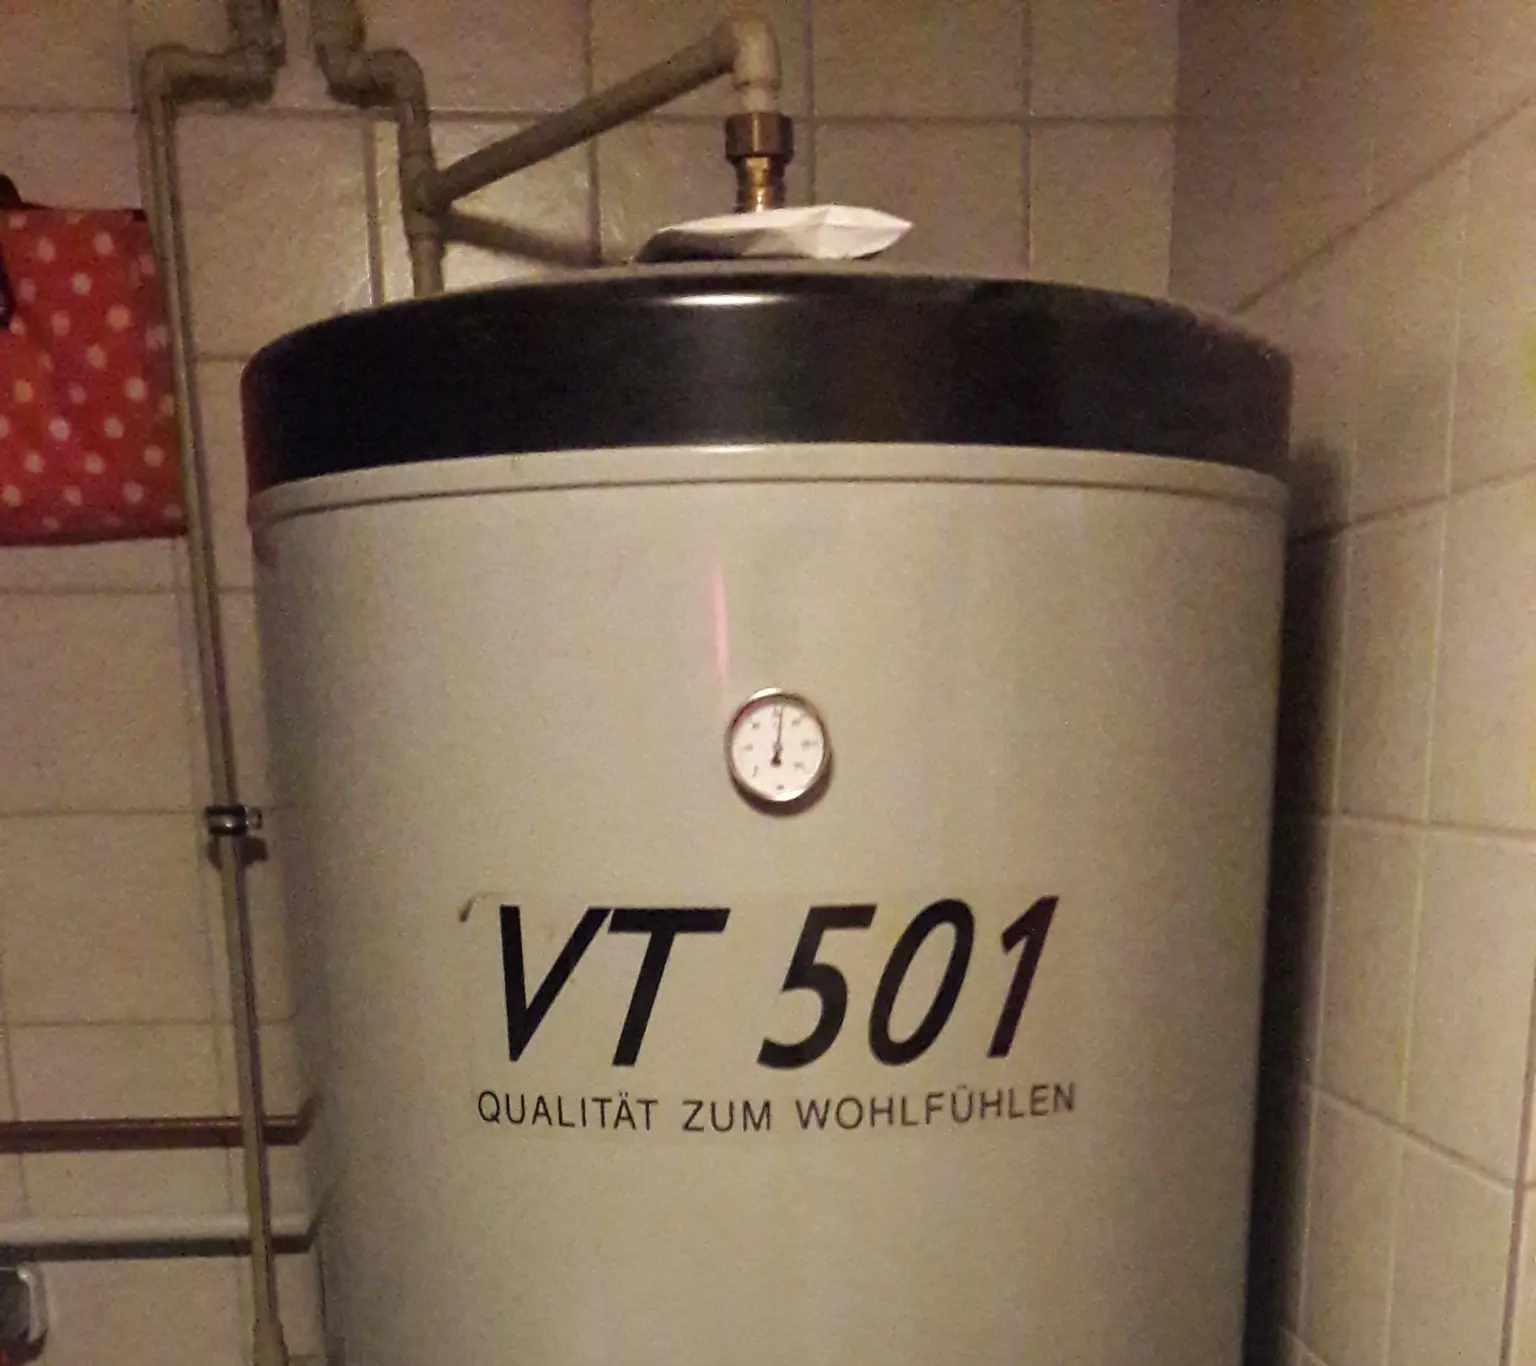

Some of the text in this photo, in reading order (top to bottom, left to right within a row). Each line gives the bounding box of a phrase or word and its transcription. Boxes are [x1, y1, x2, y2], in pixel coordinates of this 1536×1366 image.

[499, 896, 1060, 1070] VT 501
[477, 1081, 1076, 1132] QUALITÄT ZUM WOHLFÜHLEN
